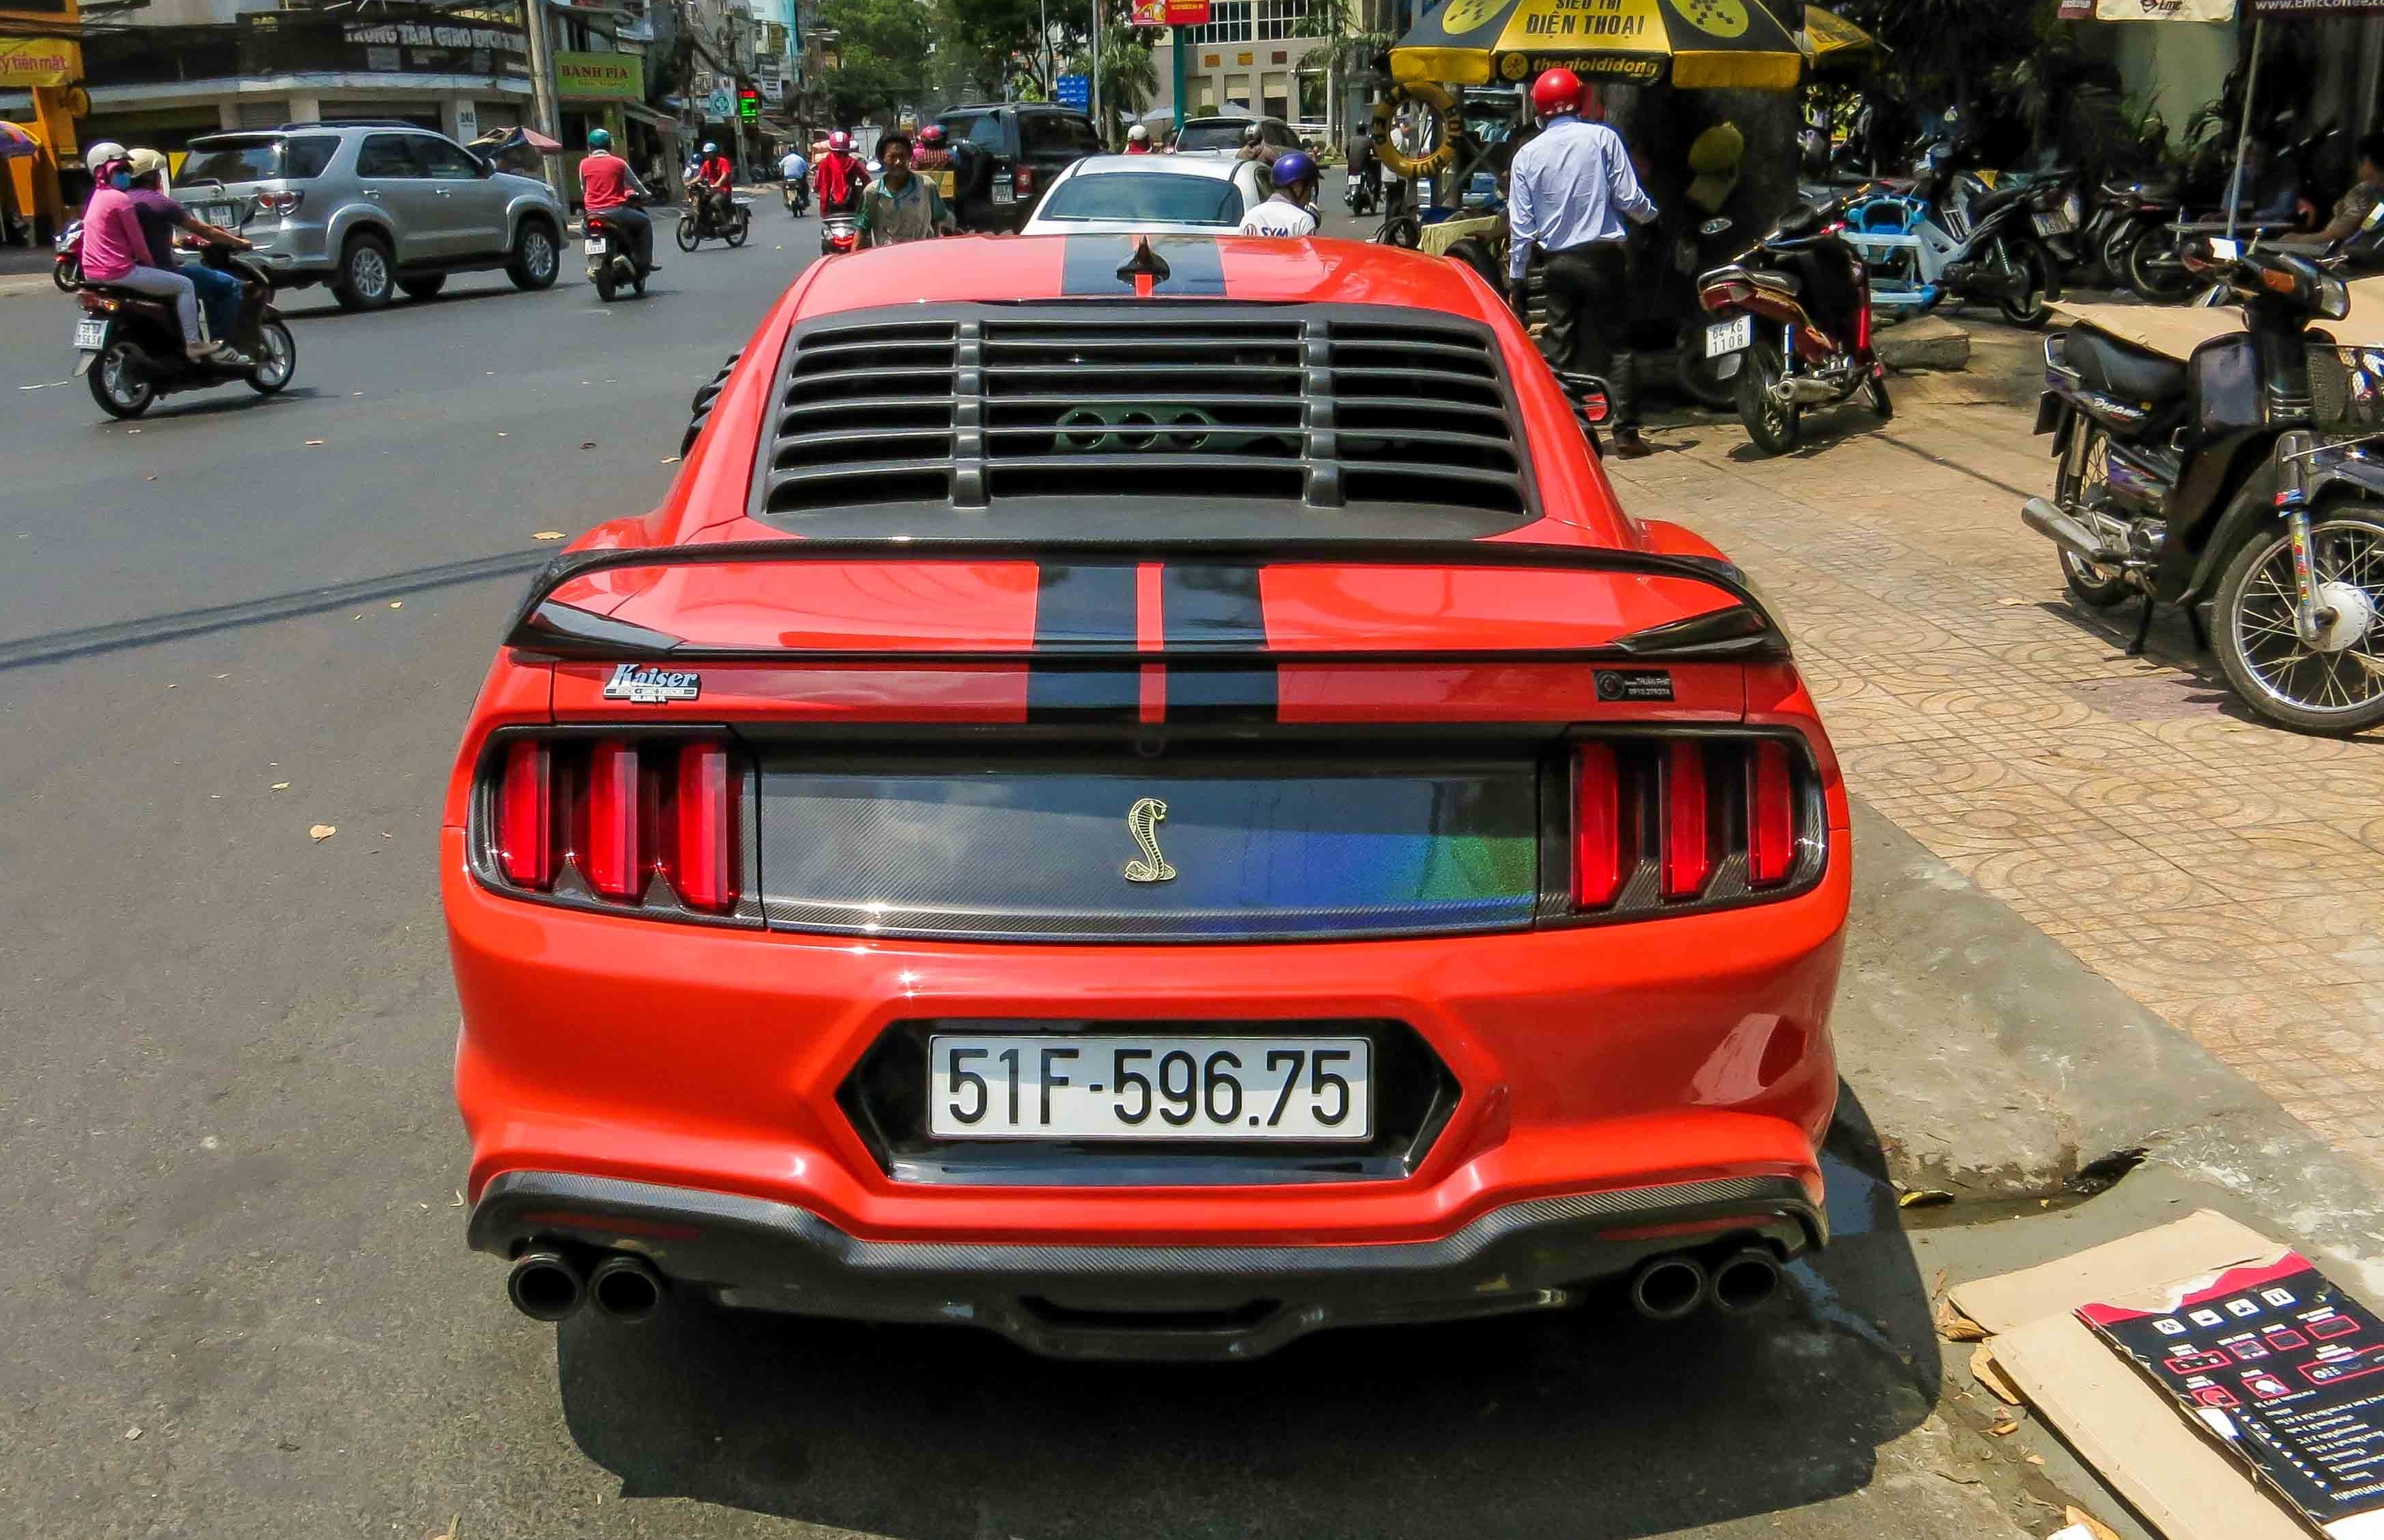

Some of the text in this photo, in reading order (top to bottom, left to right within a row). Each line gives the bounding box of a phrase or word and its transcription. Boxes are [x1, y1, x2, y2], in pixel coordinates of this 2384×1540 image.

[1526, 11, 1645, 38] ĐIỆN THOẠI
[1533, 58, 1658, 77] thegioididong
[1713, 334, 1743, 353] 1108
[605, 664, 698, 687] Kaiser
[949, 1048, 1351, 1126] 51F-596.75
